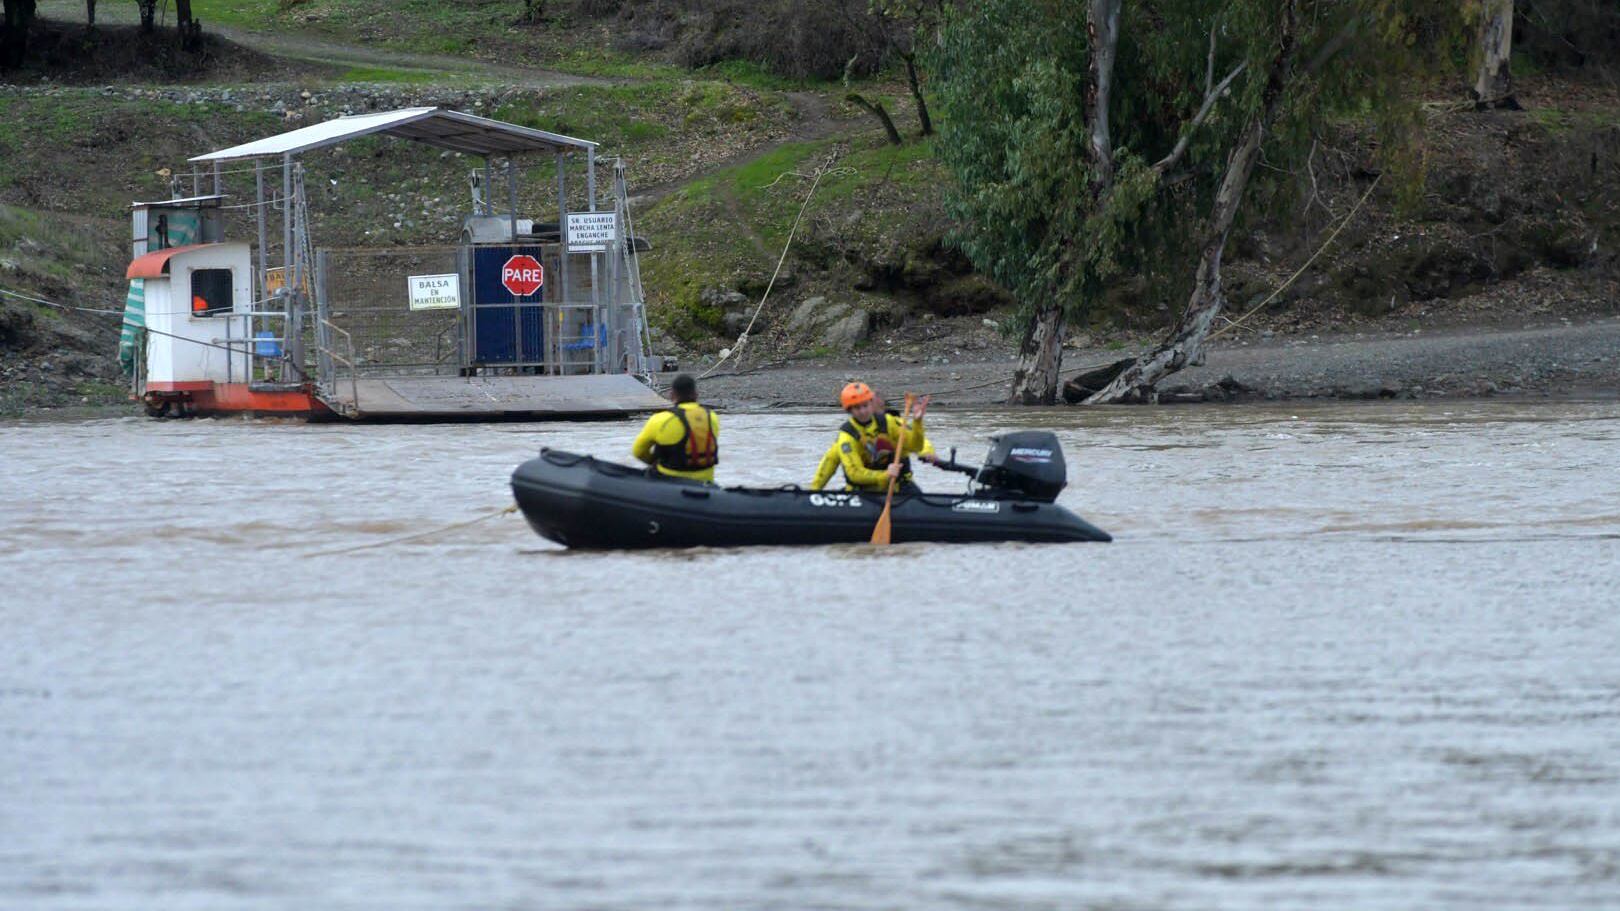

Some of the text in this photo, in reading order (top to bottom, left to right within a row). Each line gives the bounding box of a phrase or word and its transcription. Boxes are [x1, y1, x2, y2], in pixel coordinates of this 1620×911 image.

[504, 268, 541, 282] PARE
[419, 280, 449, 289] BALSA
[1010, 447, 1053, 457] MERCURY
